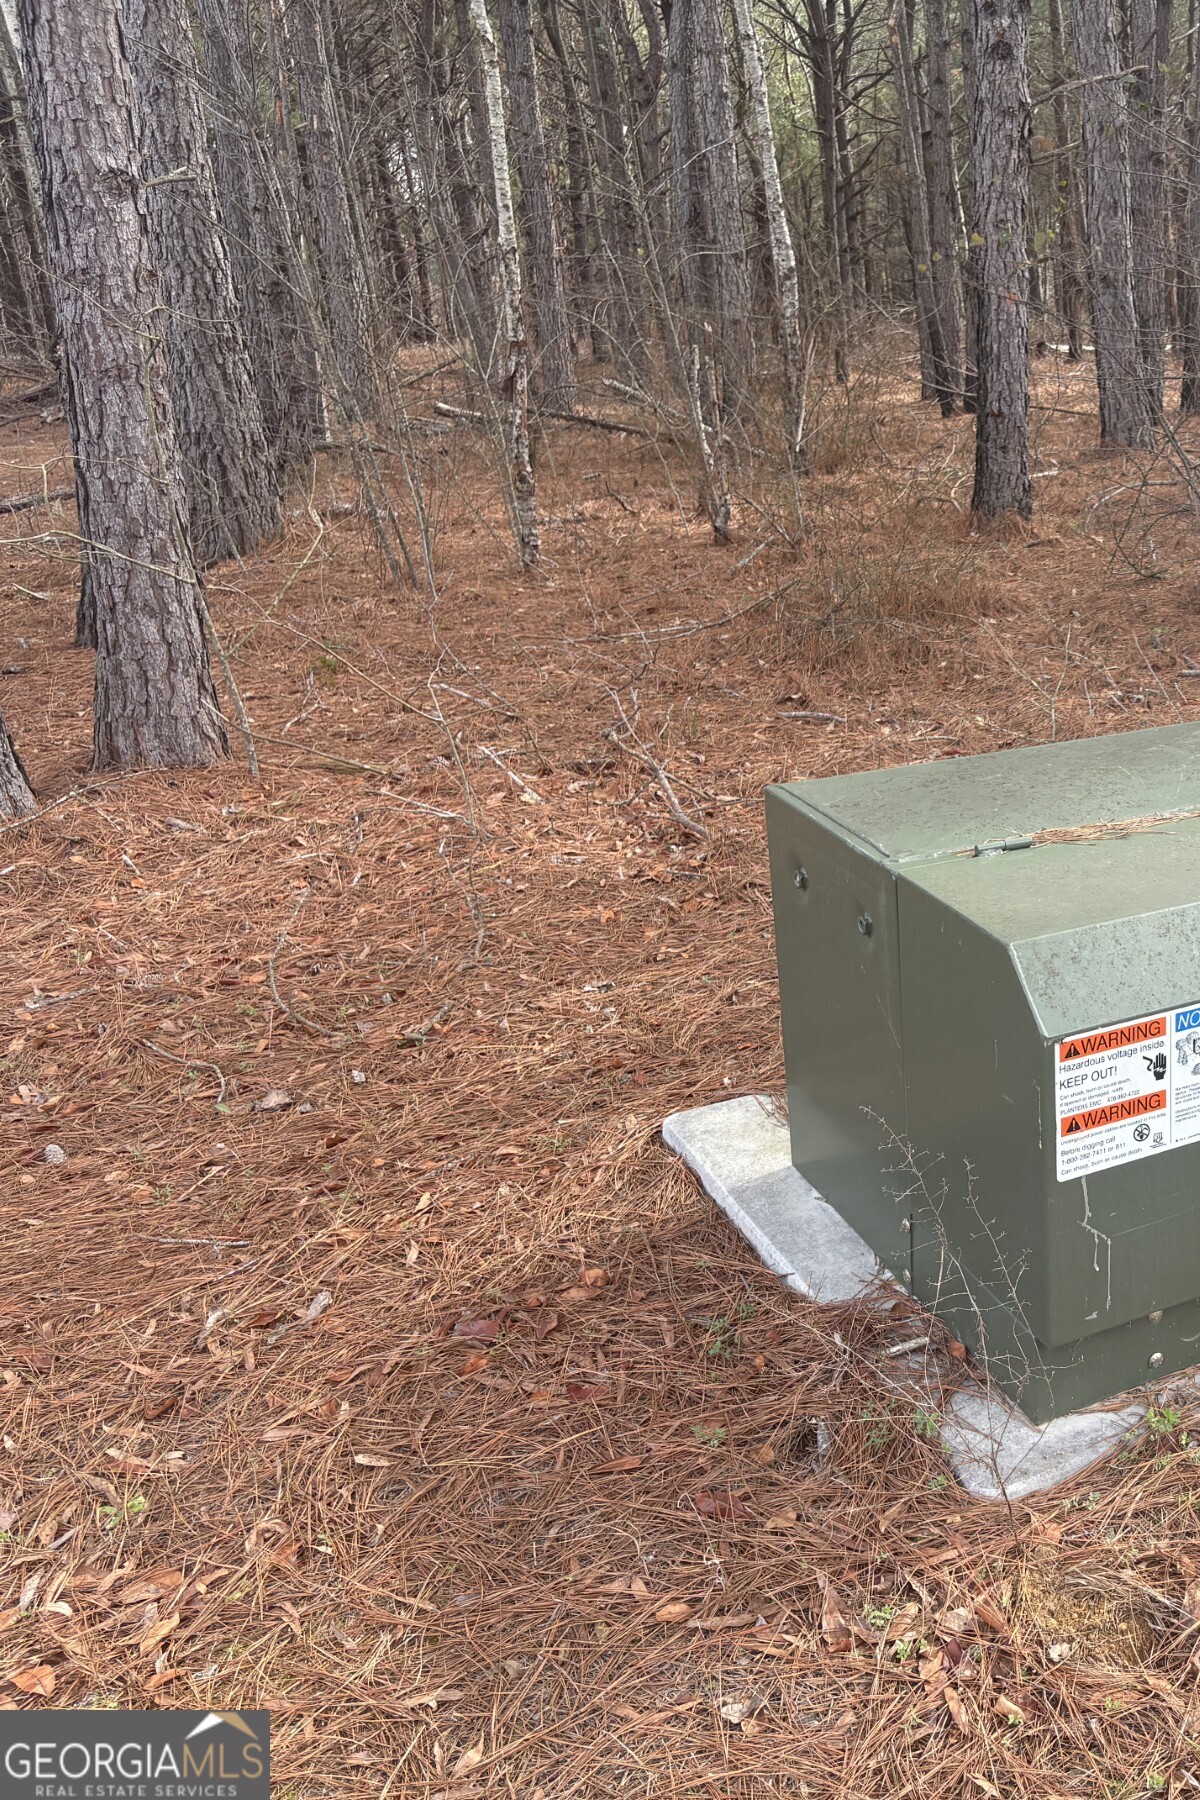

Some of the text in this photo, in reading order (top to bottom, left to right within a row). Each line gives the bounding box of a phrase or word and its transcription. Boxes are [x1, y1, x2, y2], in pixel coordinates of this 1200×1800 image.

[1081, 1021, 1161, 1054] WARNING
[1059, 1056, 1105, 1074] Hazardous
[1107, 1046, 1137, 1060] voltage
[1059, 1065, 1118, 1090] KEEP OUT!
[1082, 1094, 1161, 1128] WARNING
[1061, 1136, 1116, 1157] Before digging call
